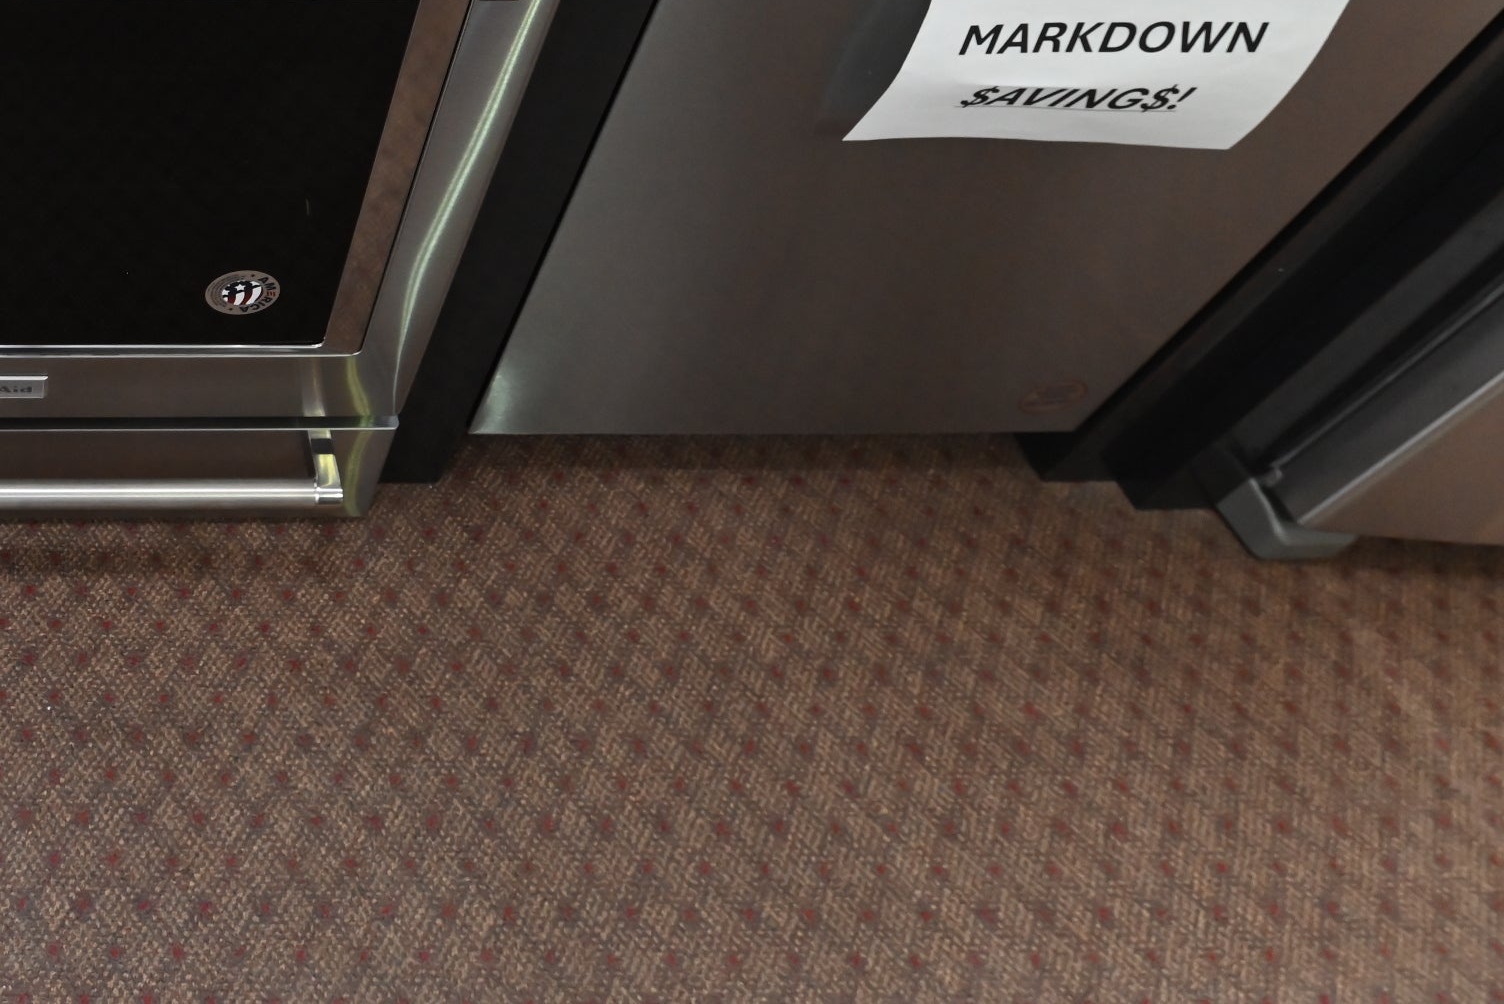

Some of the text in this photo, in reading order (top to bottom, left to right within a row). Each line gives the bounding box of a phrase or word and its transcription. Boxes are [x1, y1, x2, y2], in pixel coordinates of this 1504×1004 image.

[958, 21, 1269, 56] MARKDOWN
[960, 84, 1198, 113] $AVING$!
[239, 276, 276, 313] AMERICA
